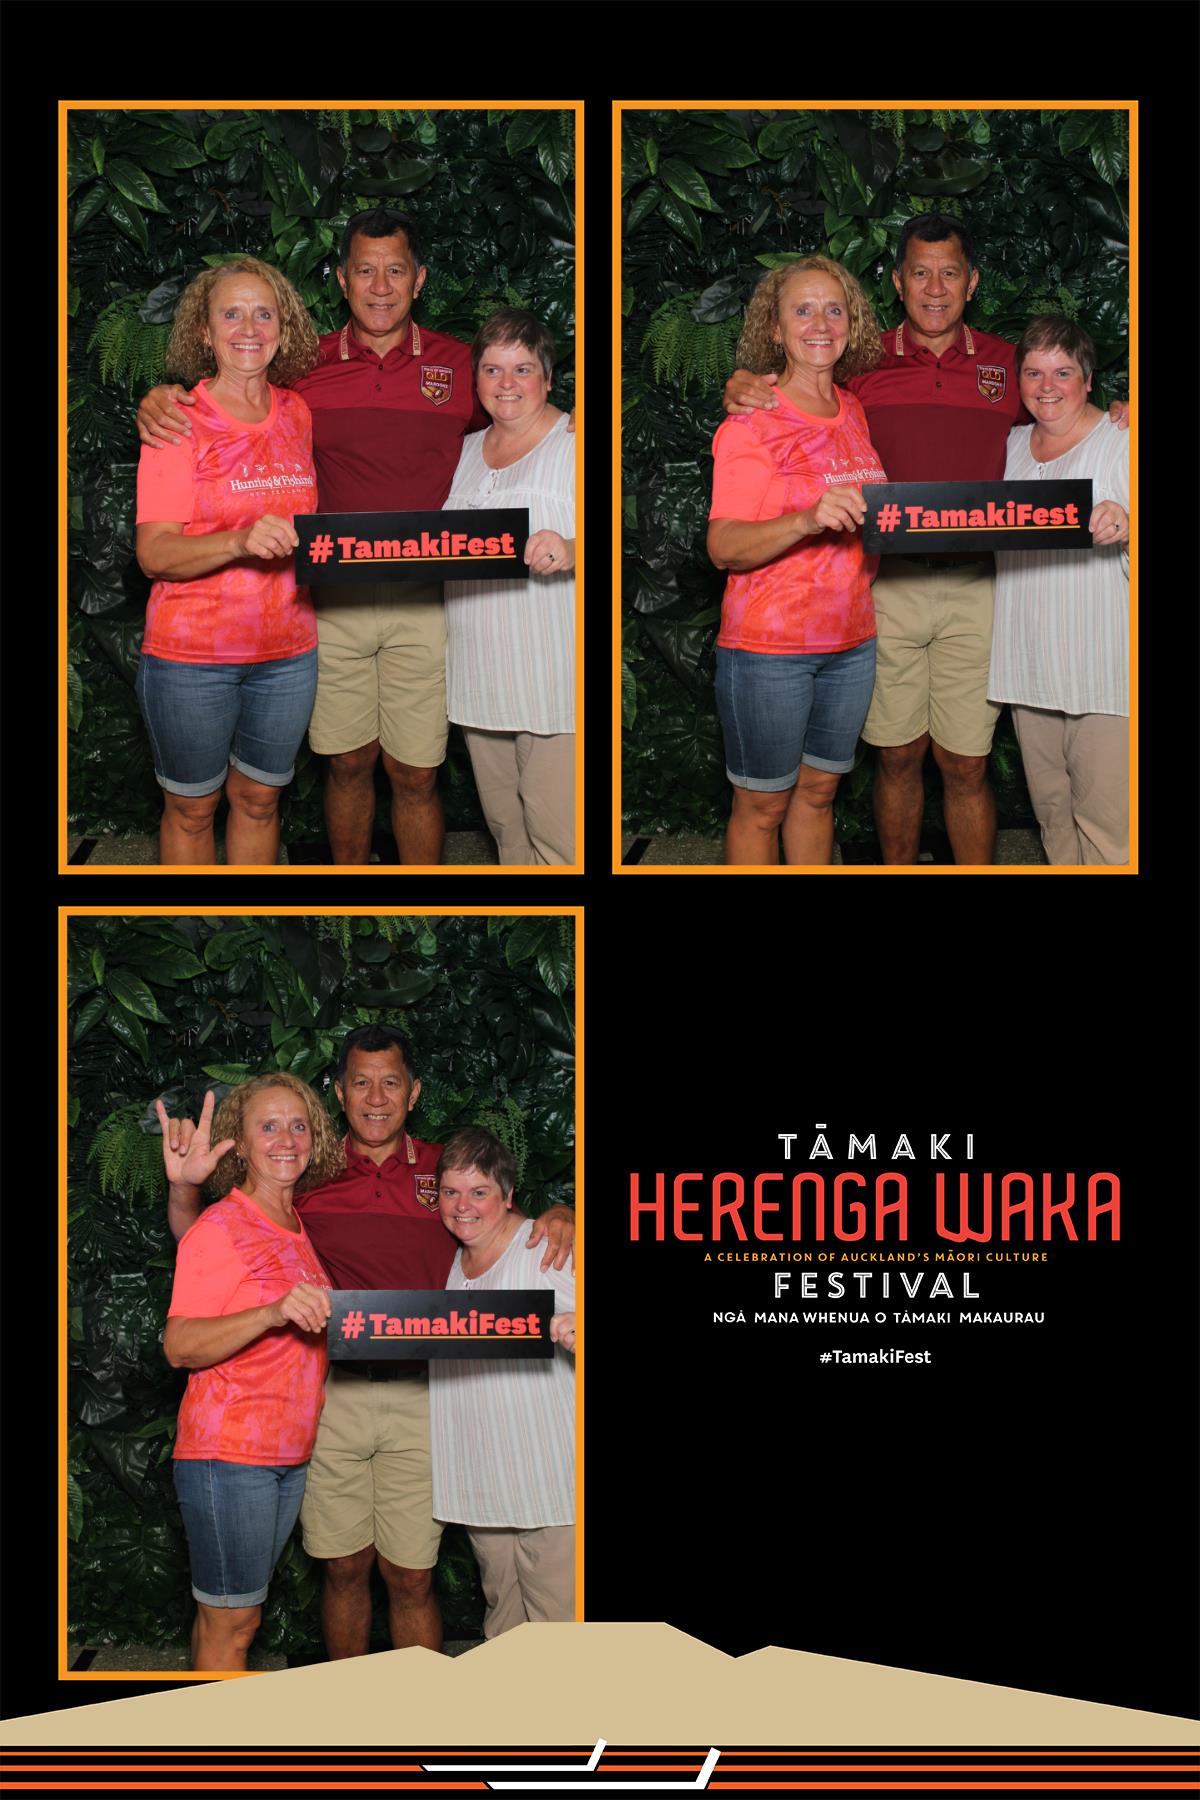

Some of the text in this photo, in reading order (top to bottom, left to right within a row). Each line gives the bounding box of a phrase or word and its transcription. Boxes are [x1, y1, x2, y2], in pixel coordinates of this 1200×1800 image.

[230, 476, 273, 491] Hunting
[877, 501, 1078, 532] #TamakiFest
[309, 531, 514, 563] #TamakiFest
[342, 1310, 541, 1339] #TamakiFest
